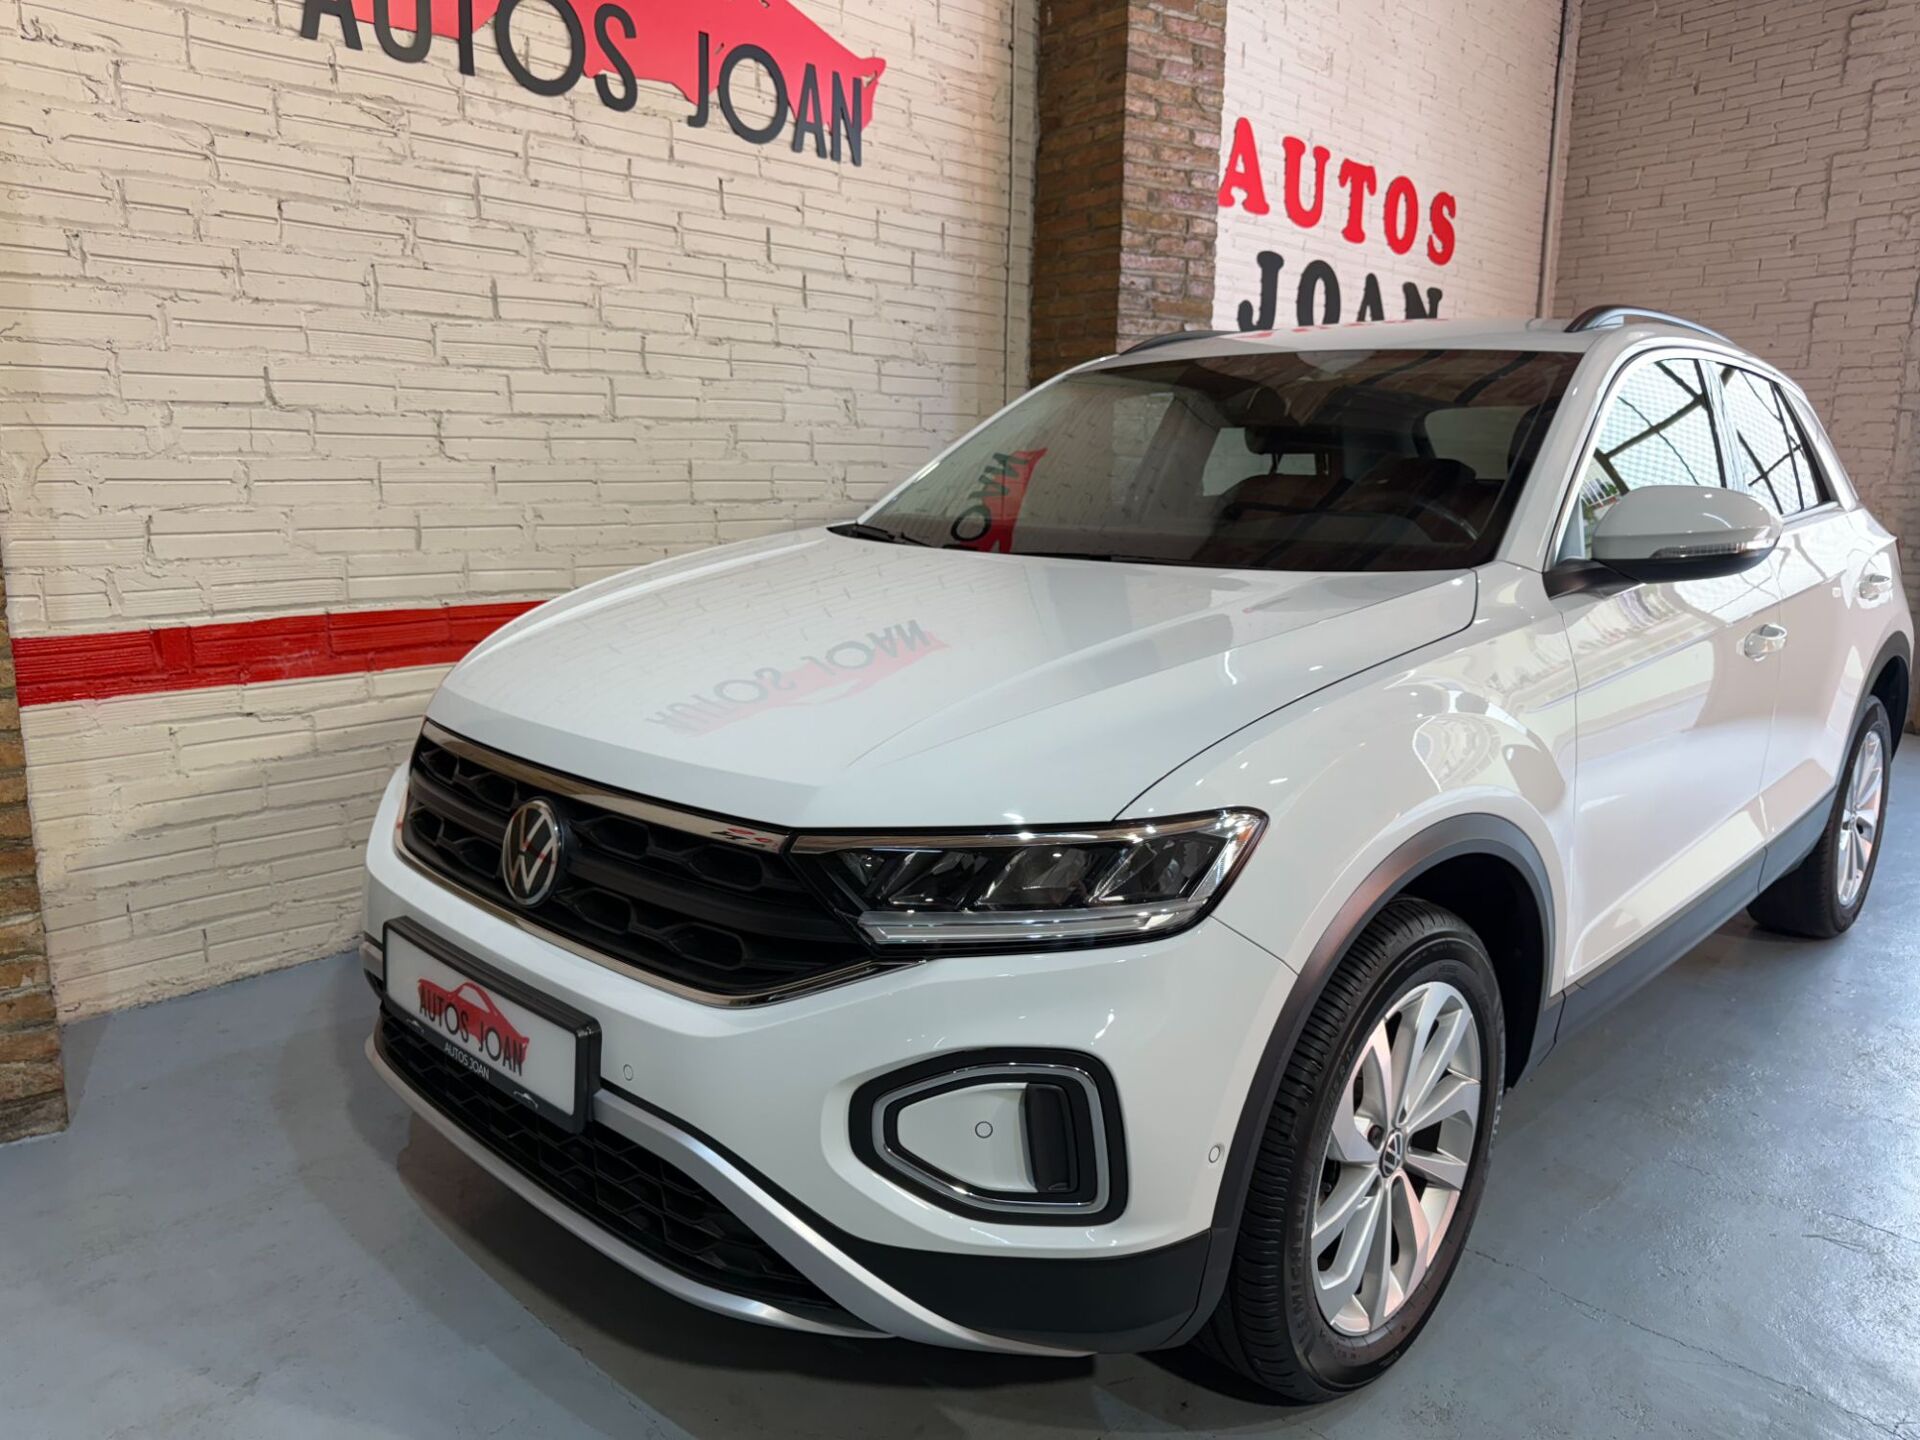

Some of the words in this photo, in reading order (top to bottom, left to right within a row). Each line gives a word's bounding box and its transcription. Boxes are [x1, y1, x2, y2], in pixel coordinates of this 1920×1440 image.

[687, 31, 862, 167] JOAN
[1218, 117, 1456, 266] AUTOS
[419, 984, 470, 1043] AUTOS
[478, 1021, 523, 1077] JOAN
[444, 1041, 469, 1066] AUTOS
[469, 1057, 490, 1080] JOAN
